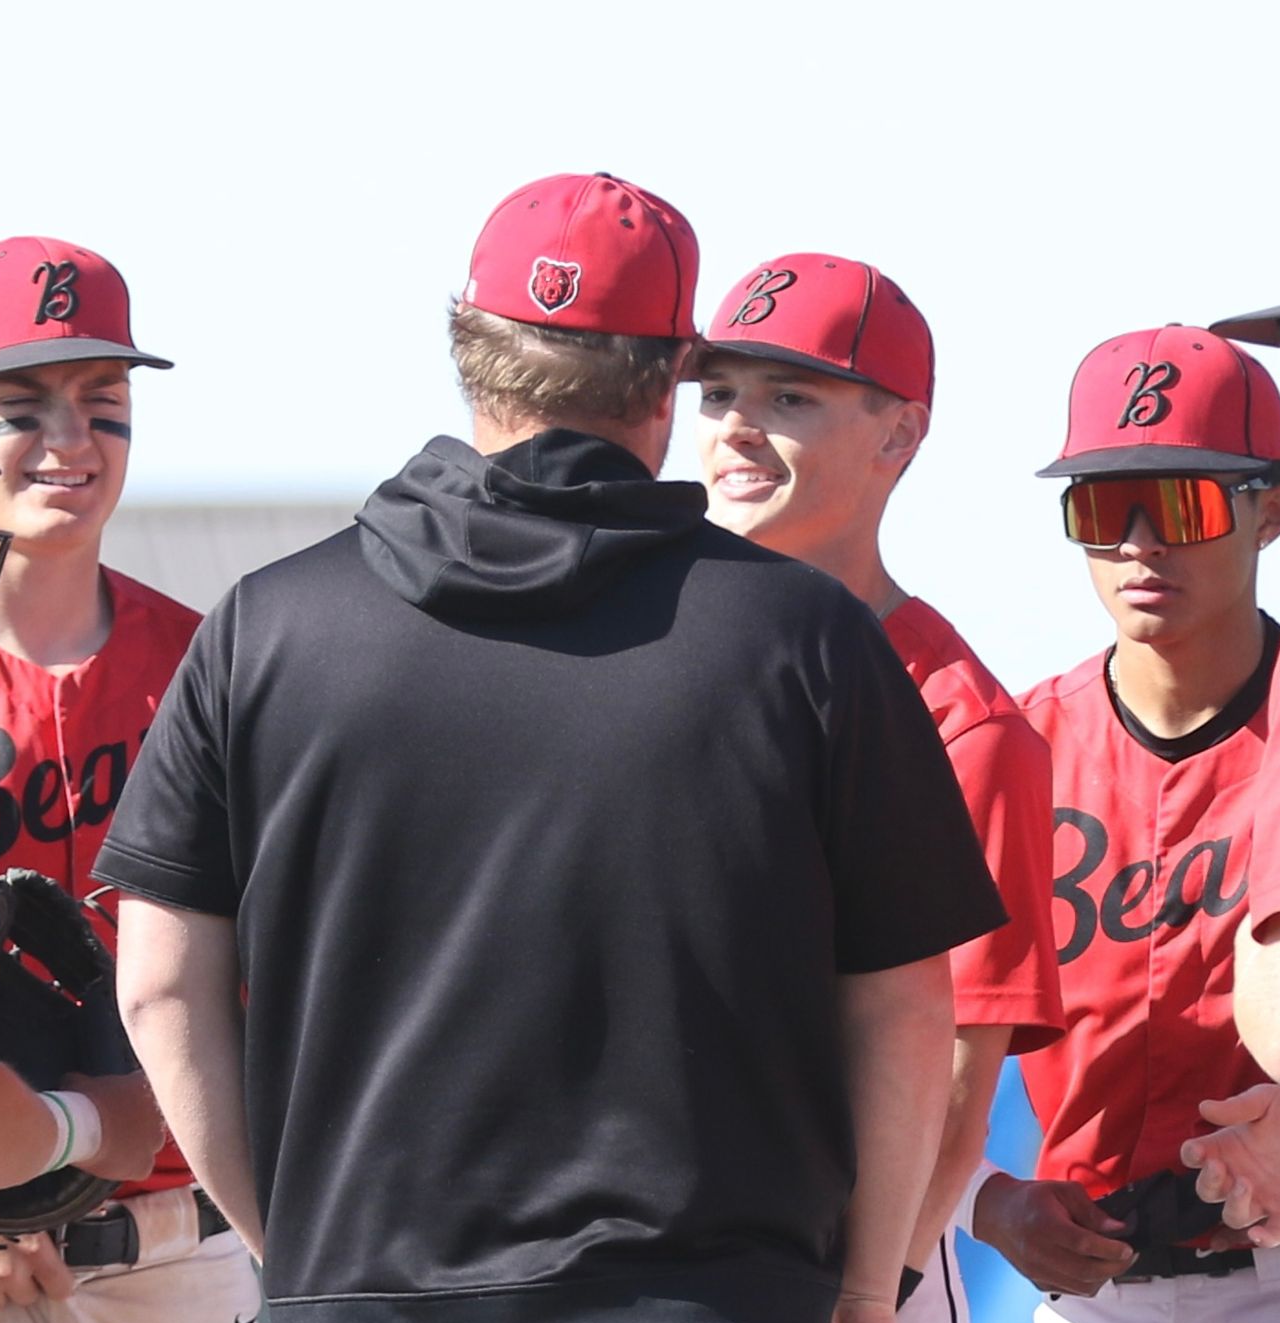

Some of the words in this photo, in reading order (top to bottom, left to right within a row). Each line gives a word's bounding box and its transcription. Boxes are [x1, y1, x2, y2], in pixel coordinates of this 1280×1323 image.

[32, 261, 81, 325] B
[727, 268, 798, 328] B
[1117, 360, 1182, 429] B
[1053, 807, 1249, 966] Bea
